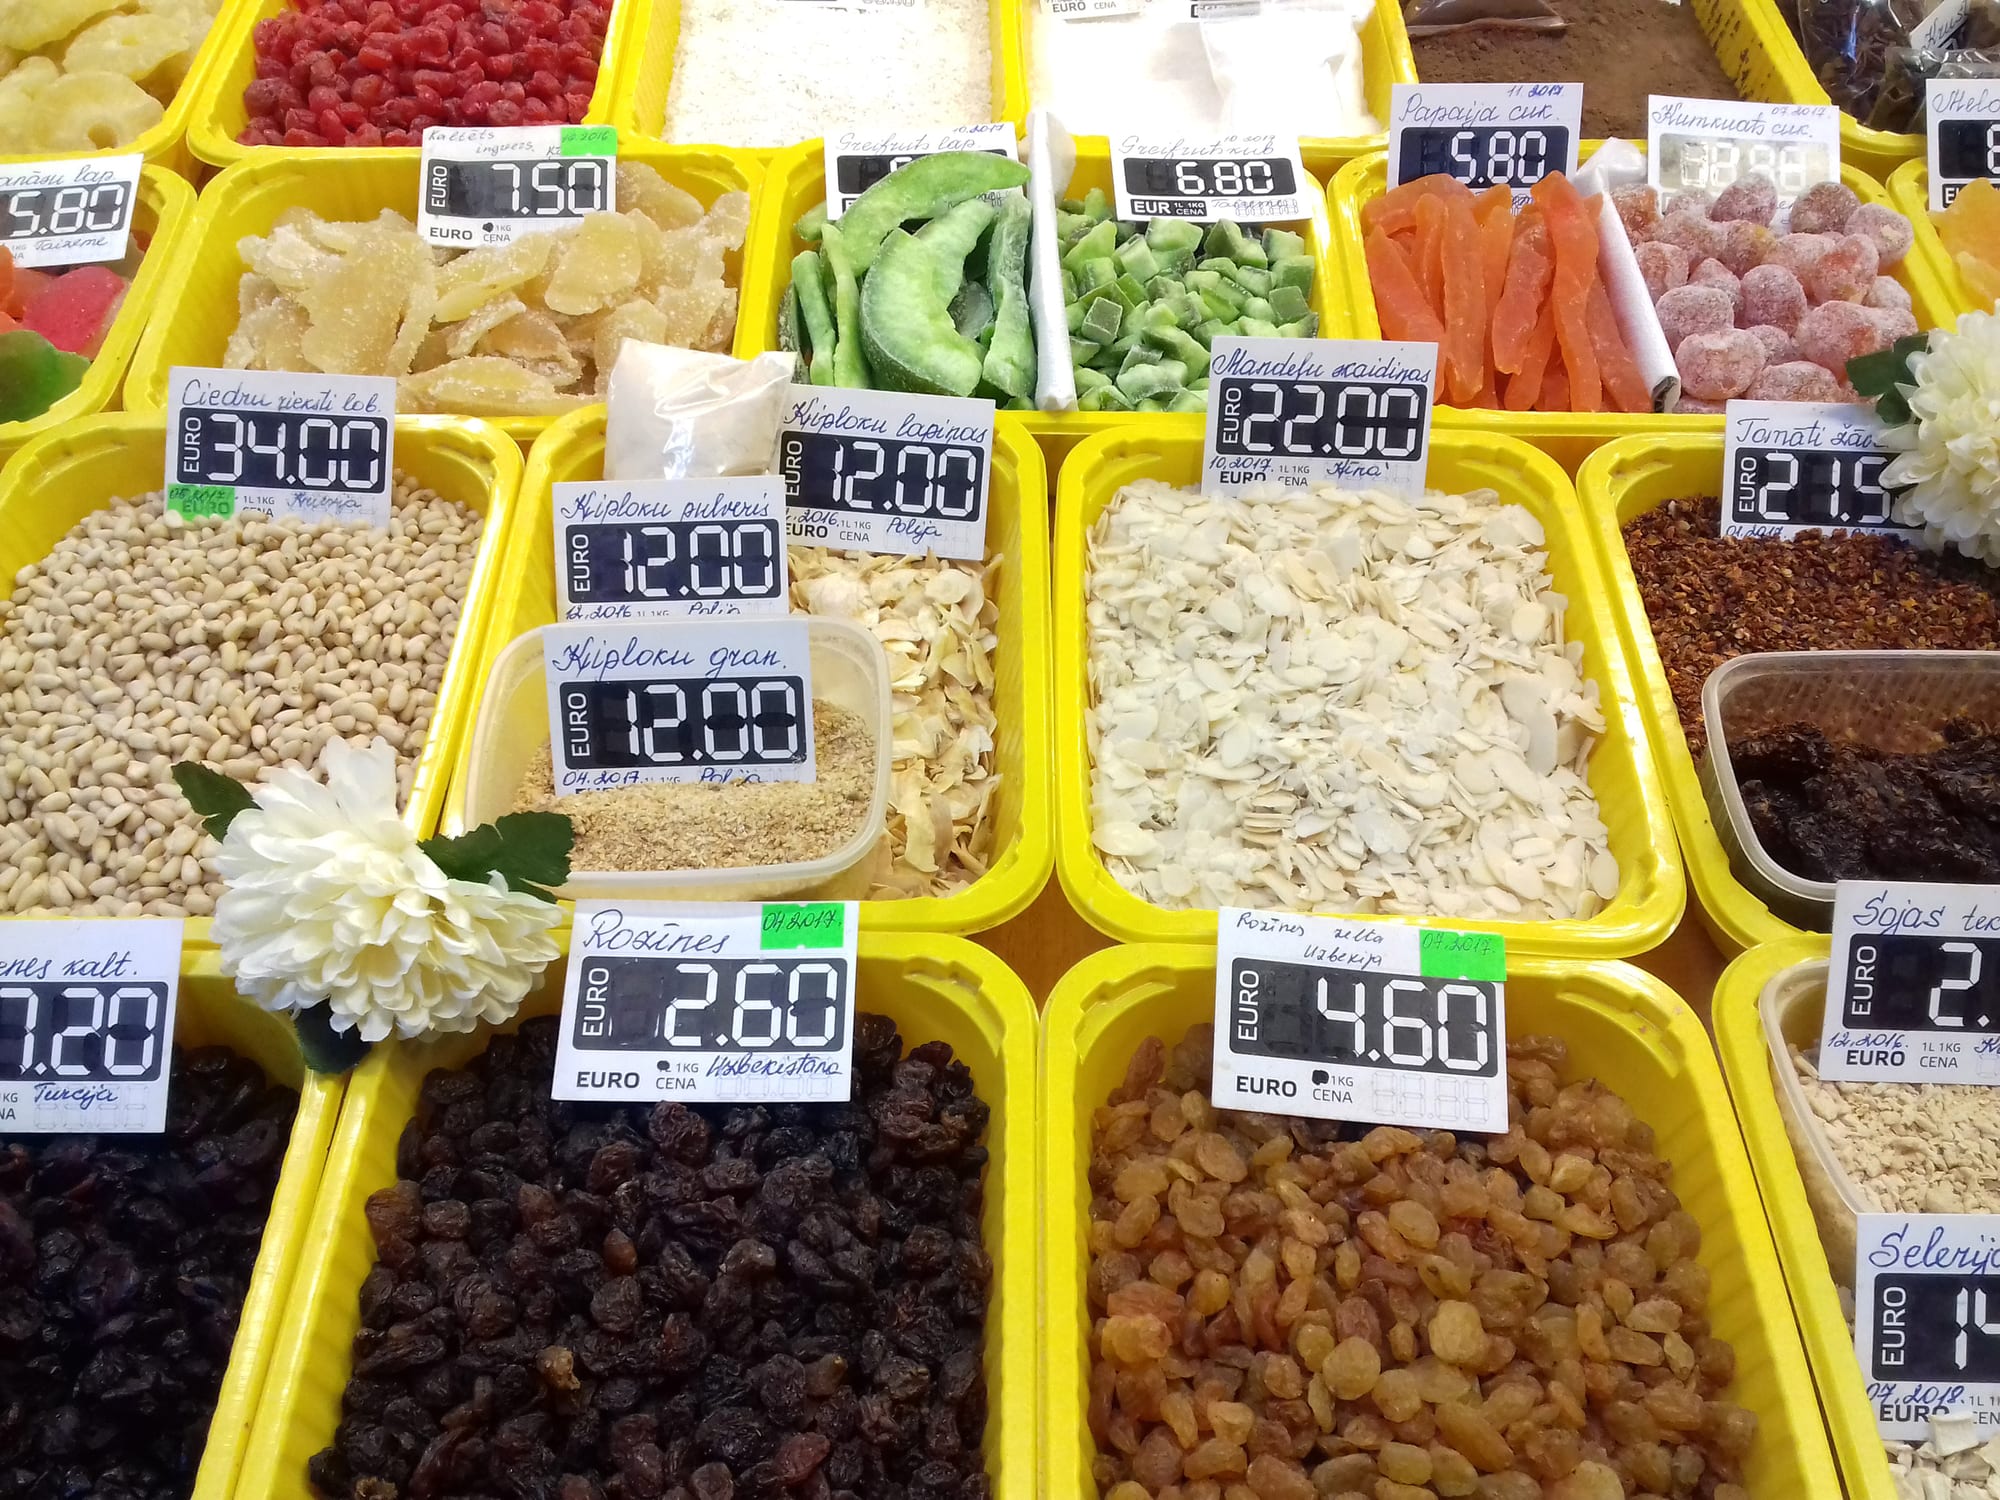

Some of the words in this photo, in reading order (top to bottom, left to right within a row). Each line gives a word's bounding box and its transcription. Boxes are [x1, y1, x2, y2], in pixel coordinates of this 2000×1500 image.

[1399, 92, 1500, 128] Papaija
[1451, 131, 1547, 184] 5.80
[431, 165, 448, 208] EURO
[491, 161, 602, 216] 7.50
[1175, 160, 1275, 195] 6.80
[9, 184, 124, 237] 5.80
[1134, 201, 1172, 214] EUR
[1176, 208, 1205, 216] CENA
[430, 227, 473, 241] EURO
[483, 233, 511, 244] CENA
[496, 225, 512, 233] 1KG
[182, 379, 273, 408] Ciedru
[1223, 387, 1242, 444] EURO
[1242, 383, 1419, 457] 22.00
[1736, 418, 1825, 448] Tomāti
[184, 416, 202, 473] EURO
[205, 413, 380, 490] 34.00
[786, 440, 803, 496] EURO
[832, 439, 977, 518] 12.00
[1220, 471, 1267, 484] EURO
[1279, 464, 1290, 473] 1L
[1292, 465, 1310, 474] 1KG
[1739, 456, 1757, 513] EURO
[182, 502, 229, 514] EURO
[243, 495, 254, 505] 1L
[256, 496, 275, 505] 1KG
[839, 530, 870, 542] CENA
[841, 519, 851, 529] 1L
[854, 521, 872, 530] 1KG
[572, 533, 590, 592] EURO
[622, 523, 774, 597] 12.00
[568, 692, 591, 757] EURO
[626, 681, 799, 762] 12.00
[583, 909, 730, 954] Rozīnes
[1852, 945, 1877, 1016] EURO
[1929, 941, 1991, 1027] 2.
[582, 967, 610, 1037] EURO
[663, 963, 838, 1047] 2.60
[1238, 970, 1260, 1042] EURO
[0, 987, 158, 1076] 7.20
[1317, 976, 1488, 1071] 4.60
[1846, 1051, 1906, 1067] EURO
[1919, 1056, 1959, 1069] CENA
[1923, 1042, 1935, 1052] 1L
[1940, 1043, 1961, 1053] 1KG
[576, 1071, 641, 1089] EURO
[655, 1077, 697, 1090] CENA
[676, 1063, 699, 1074] 1KG
[1236, 1075, 1297, 1098] EURO
[1331, 1075, 1354, 1088] 1KG
[1312, 1089, 1353, 1104] CENA
[1882, 1286, 1906, 1366] EURO
[1969, 1396, 1984, 1407] 1L
